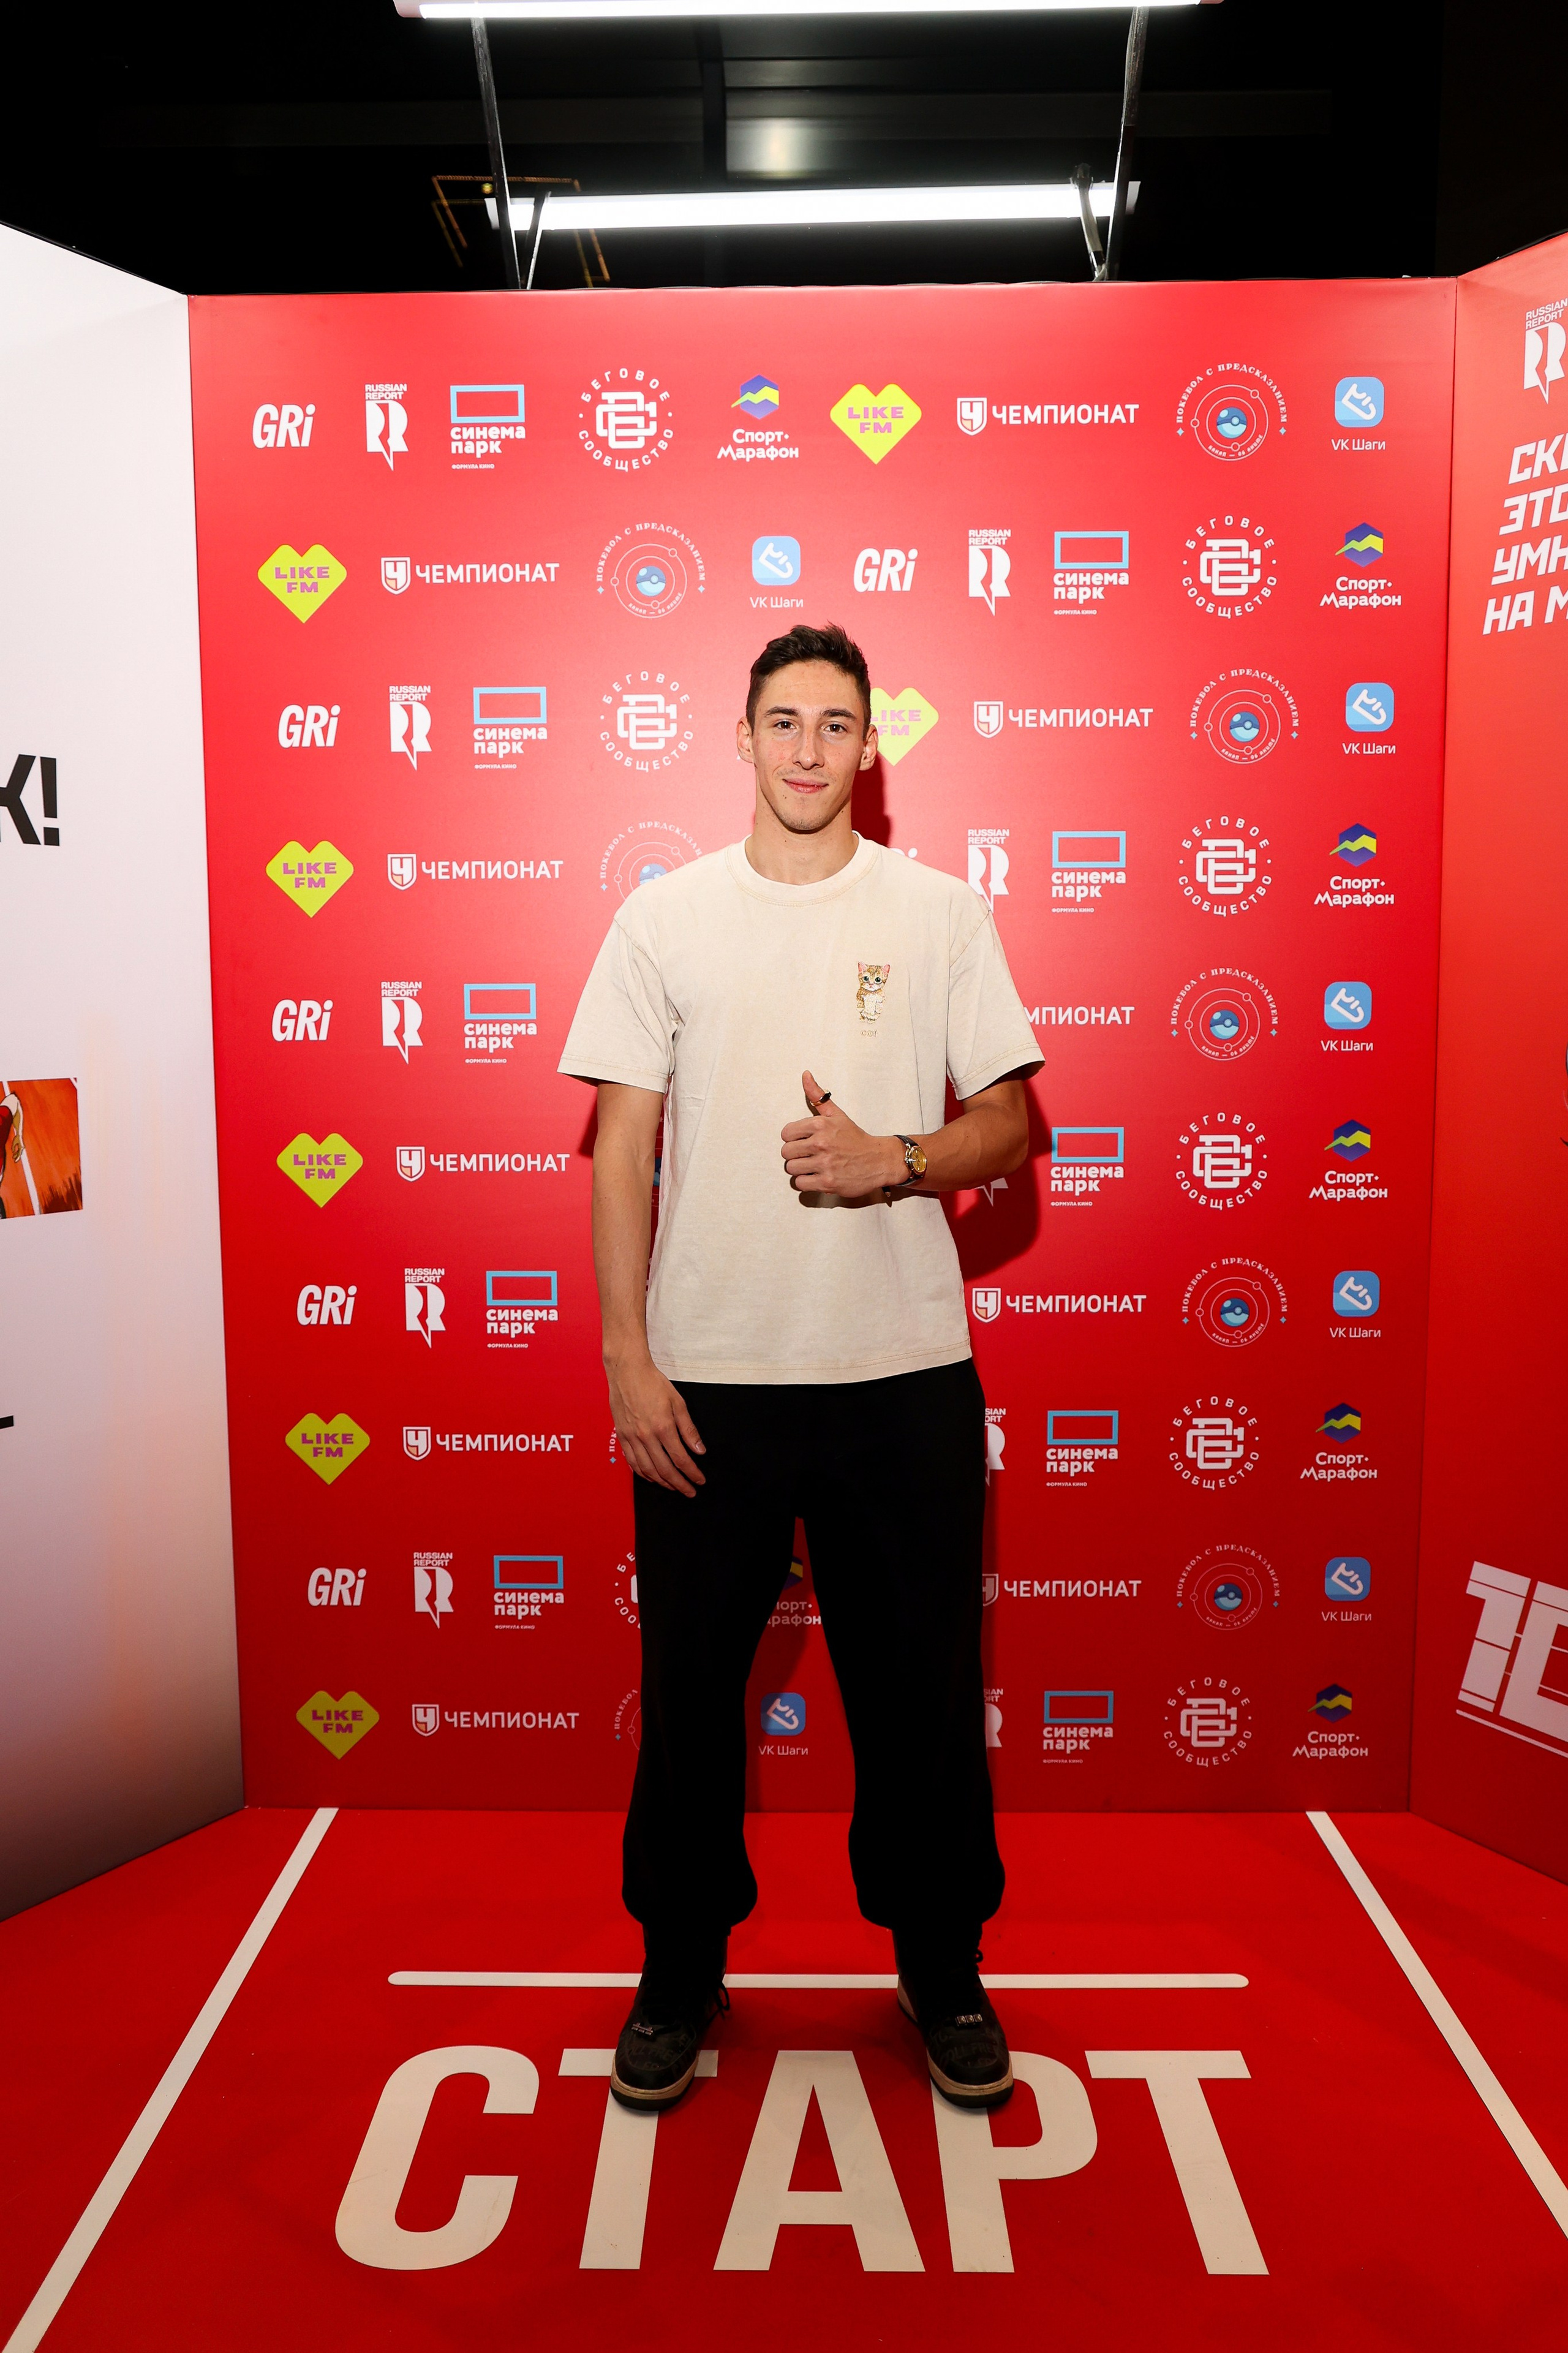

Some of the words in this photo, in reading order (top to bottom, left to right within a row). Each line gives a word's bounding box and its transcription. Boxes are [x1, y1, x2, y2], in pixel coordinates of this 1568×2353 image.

[1526, 298, 1568, 320] RUSSIAN
[1526, 309, 1564, 330] REPORT
[365, 383, 407, 392] RUSSIAN
[581, 368, 669, 402] БЕГОВОЕ
[848, 407, 903, 418] LIKE
[992, 404, 1139, 425] ЧЕМПИОНАТ
[860, 422, 892, 433] FM
[579, 429, 673, 472] СООБЩЕСТВО
[1332, 439, 1349, 450] VK
[1352, 439, 1385, 450] Шаги
[717, 445, 799, 462] Марафон
[1186, 516, 1274, 549] БЕГОВОЕ
[969, 537, 1007, 546] REPORT
[275, 567, 330, 579] LIKE
[416, 563, 559, 583] ЧЕМПИОНАТ
[287, 582, 318, 593] FM
[750, 597, 767, 608] VK
[771, 597, 803, 608] Шаги
[1183, 576, 1276, 619] СООБЩЕСТВО
[1320, 592, 1401, 609] Марафон
[1482, 590, 1534, 635] НА
[603, 671, 690, 704] БЕГОВОЕ
[1009, 708, 1153, 727] ЧЕМПИОНАТ
[878, 725, 910, 736] FM
[600, 731, 693, 772] СООБЩЕСТВО
[1343, 743, 1360, 753] VK
[1363, 743, 1395, 753] Шаги
[639, 821, 703, 858] ПРЕДСКАЗАН
[1182, 816, 1269, 848] БЕГОВОЕ
[283, 863, 336, 874] LIKE
[422, 860, 564, 879] ЧЕМПИОНАТ
[295, 877, 325, 888] FM
[1178, 876, 1272, 916] СООБЩЕСТВО
[1314, 891, 1394, 908] Марафон
[1023, 1007, 1134, 1025] МПИОНАТ
[1321, 1040, 1338, 1051] VK
[1341, 1040, 1373, 1051] Шаги
[1179, 1112, 1265, 1144] БЕГОВОЕ
[293, 1154, 346, 1165] LIKE
[431, 1154, 570, 1171] ЧЕМПИОНАТ
[305, 1168, 335, 1179] FM
[1176, 1171, 1267, 1210] СООБЩЕСТВО
[1309, 1185, 1387, 1201] Марафон
[1006, 1295, 1146, 1312] ЧЕМПИОНАТ
[1330, 1328, 1346, 1337] VK
[1349, 1328, 1381, 1337] Шаги
[1173, 1396, 1257, 1427] БЕГОВОЕ
[301, 1433, 353, 1445] LIKE
[436, 1434, 573, 1451] ЧЕМПИОНАТ
[313, 1447, 342, 1457] FM
[1169, 1452, 1259, 1490] СООБЩЕСТВО
[1300, 1465, 1377, 1482] Марафон
[1004, 1581, 1141, 1597] ЧЕМПИОНАТ
[767, 1614, 821, 1627] рафон
[1322, 1612, 1337, 1621] VK
[1341, 1612, 1371, 1621] Шаги
[1167, 1677, 1250, 1706] БЕГОВОЕ
[312, 1710, 363, 1721] LIKE
[445, 1712, 579, 1729] ЧЕМПИОНАТ
[323, 1723, 352, 1733] FM
[759, 1746, 774, 1754] VK
[778, 1746, 808, 1755] Шаги
[1164, 1731, 1251, 1767] СООБЩЕСТВО
[1293, 1745, 1368, 1759] Марафон
[334, 2044, 1270, 2275] СТАРТ
